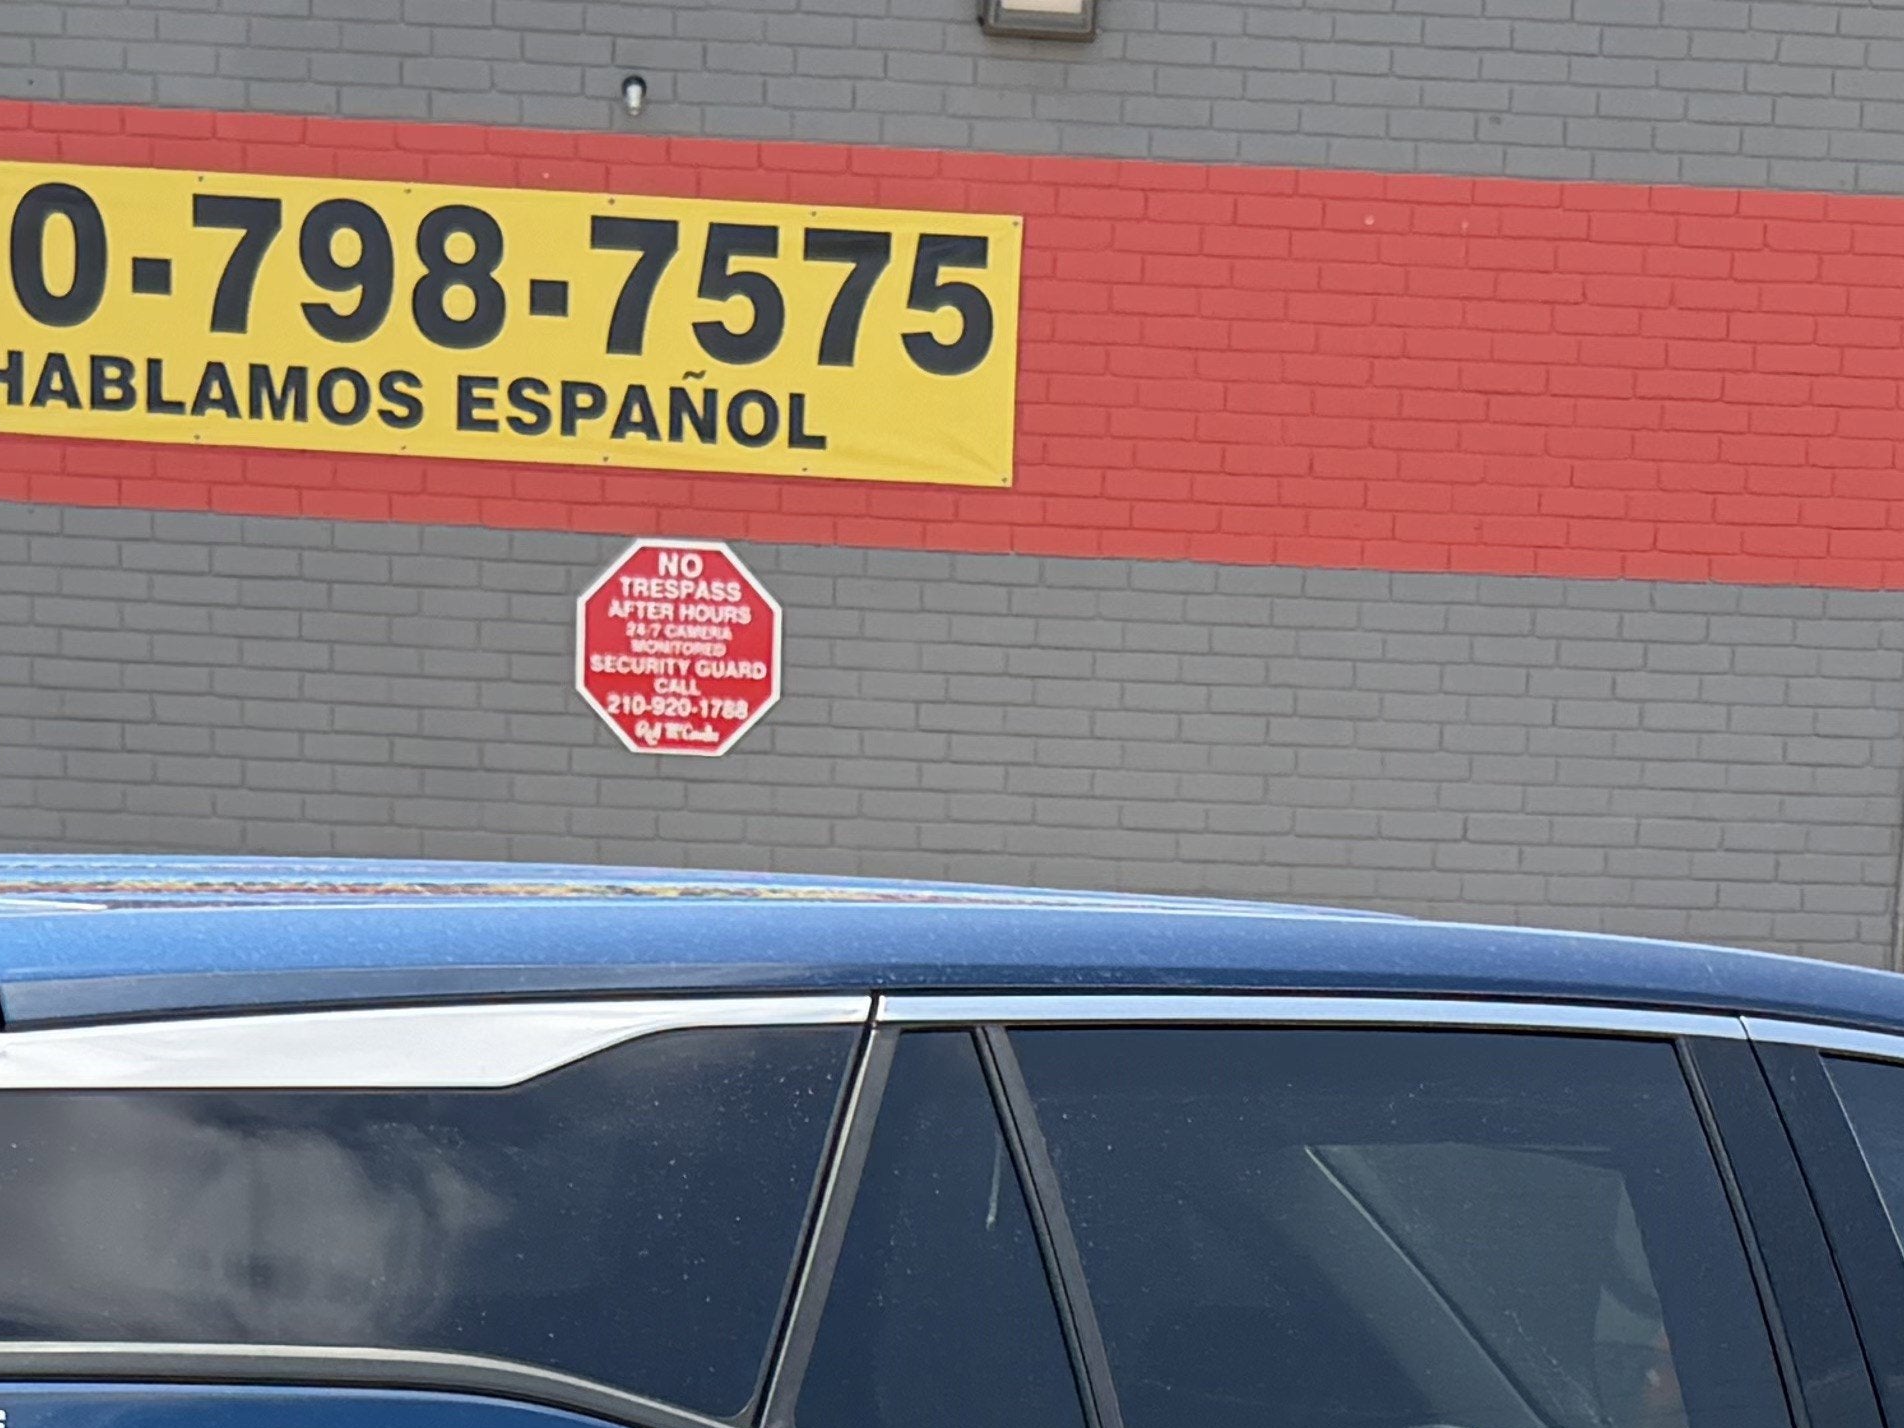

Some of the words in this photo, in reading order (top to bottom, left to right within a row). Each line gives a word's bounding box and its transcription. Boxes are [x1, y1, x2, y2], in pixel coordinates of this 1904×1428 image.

[456, 370, 827, 450] ESPAÑOL
[658, 552, 703, 578] NO
[620, 576, 742, 602] TRESPASS
[608, 600, 674, 621] AFTER
[679, 603, 752, 624] HOURS
[589, 654, 691, 676] SECURITY
[695, 661, 767, 680] GUARD
[653, 678, 701, 696] CALL
